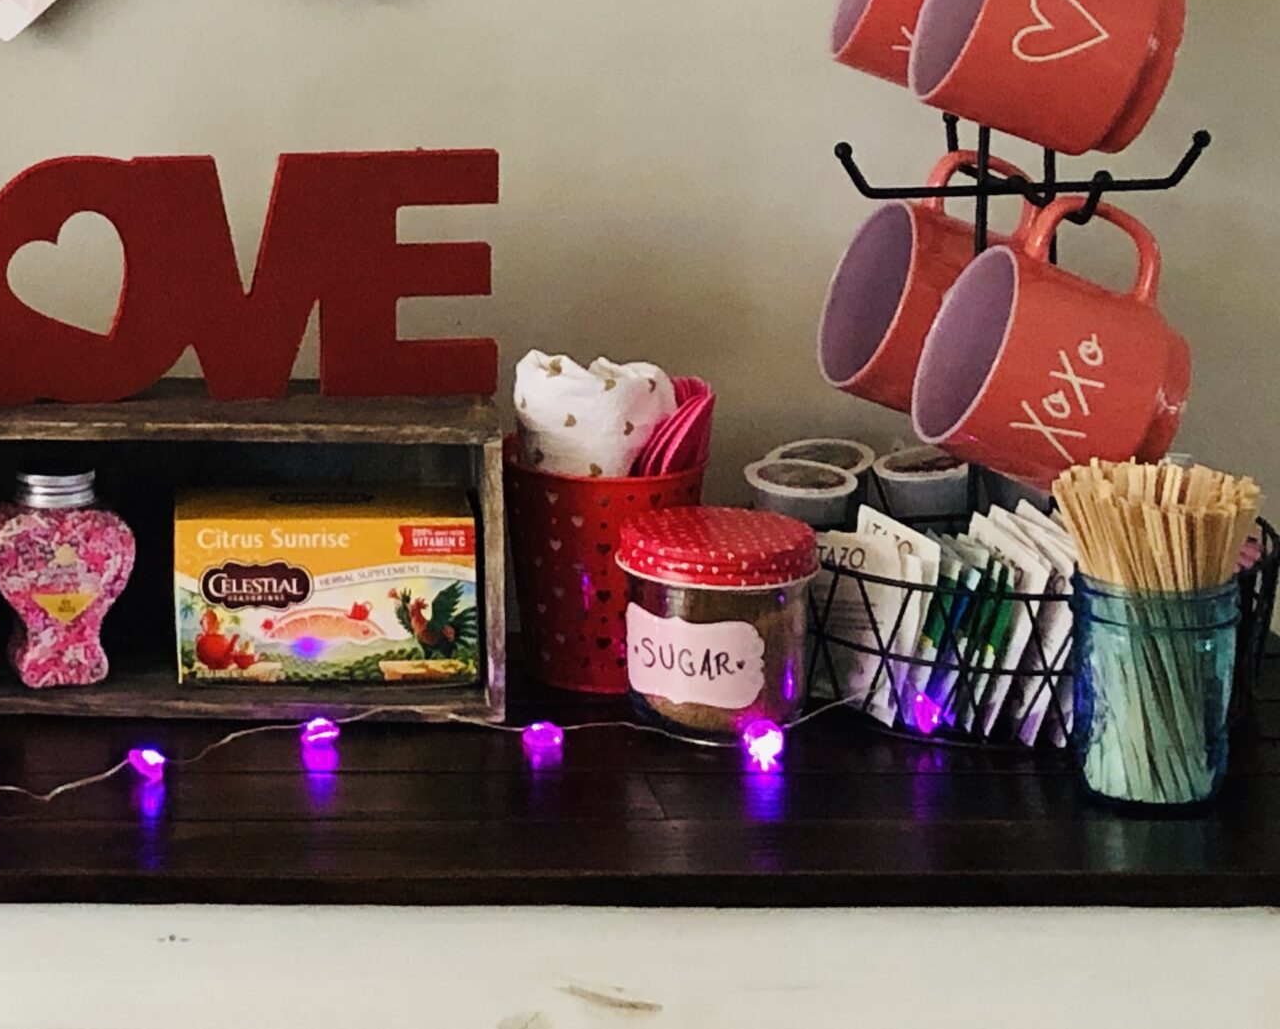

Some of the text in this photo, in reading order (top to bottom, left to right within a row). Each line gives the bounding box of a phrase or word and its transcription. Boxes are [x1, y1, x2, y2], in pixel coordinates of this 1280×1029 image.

[196, 526, 351, 550] Citrus Sunrise
[411, 536, 466, 548] VITAMIN C
[816, 544, 866, 571] TAZO
[357, 563, 421, 581] SUPPLEMENT
[207, 572, 304, 598] CELESTIAL
[639, 636, 736, 682] SUGAR
